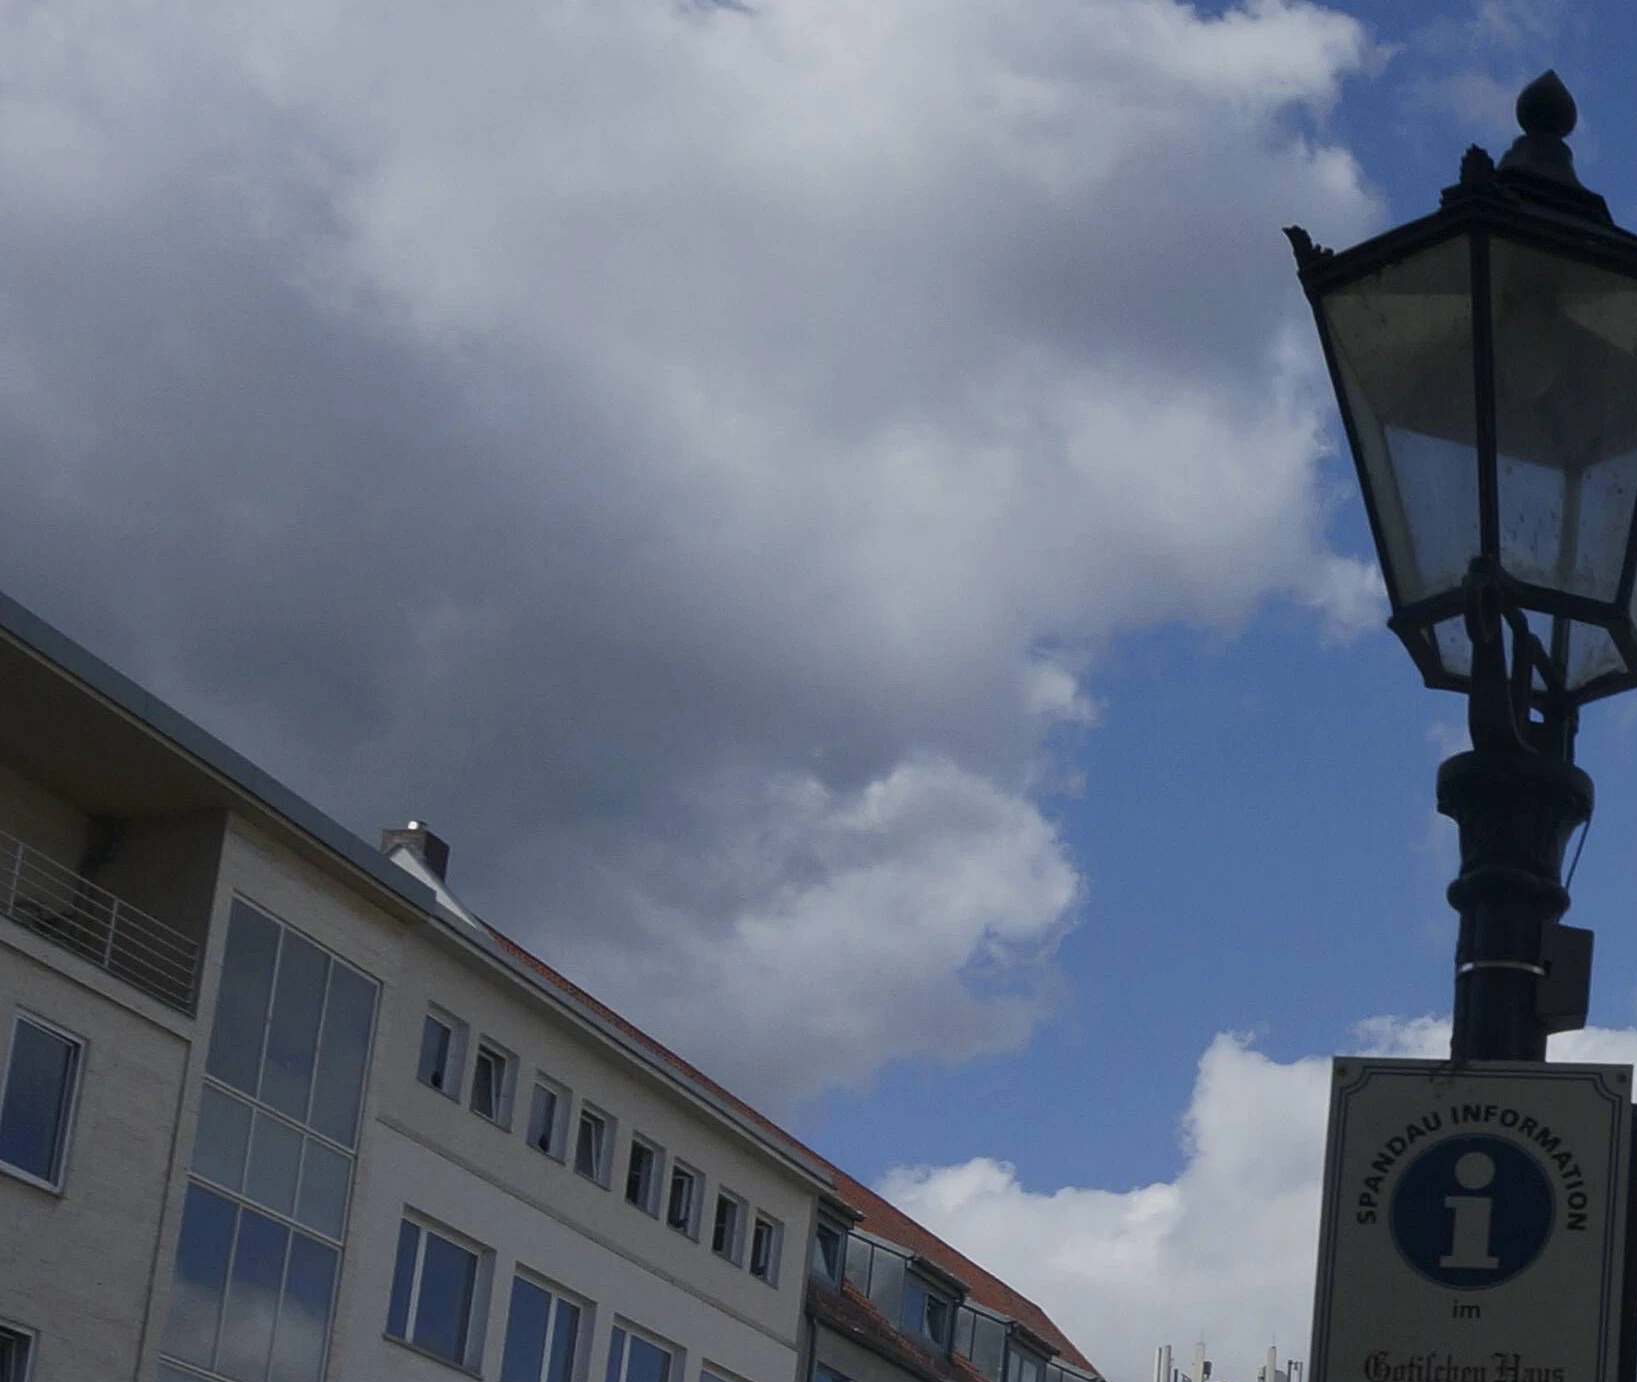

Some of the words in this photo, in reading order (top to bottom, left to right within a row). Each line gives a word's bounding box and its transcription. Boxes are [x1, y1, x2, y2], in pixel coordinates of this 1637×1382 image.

[1356, 1111, 1443, 1225] SPANDAU
[1450, 1104, 1588, 1231] INFORMATION
[1452, 1300, 1481, 1319] im
